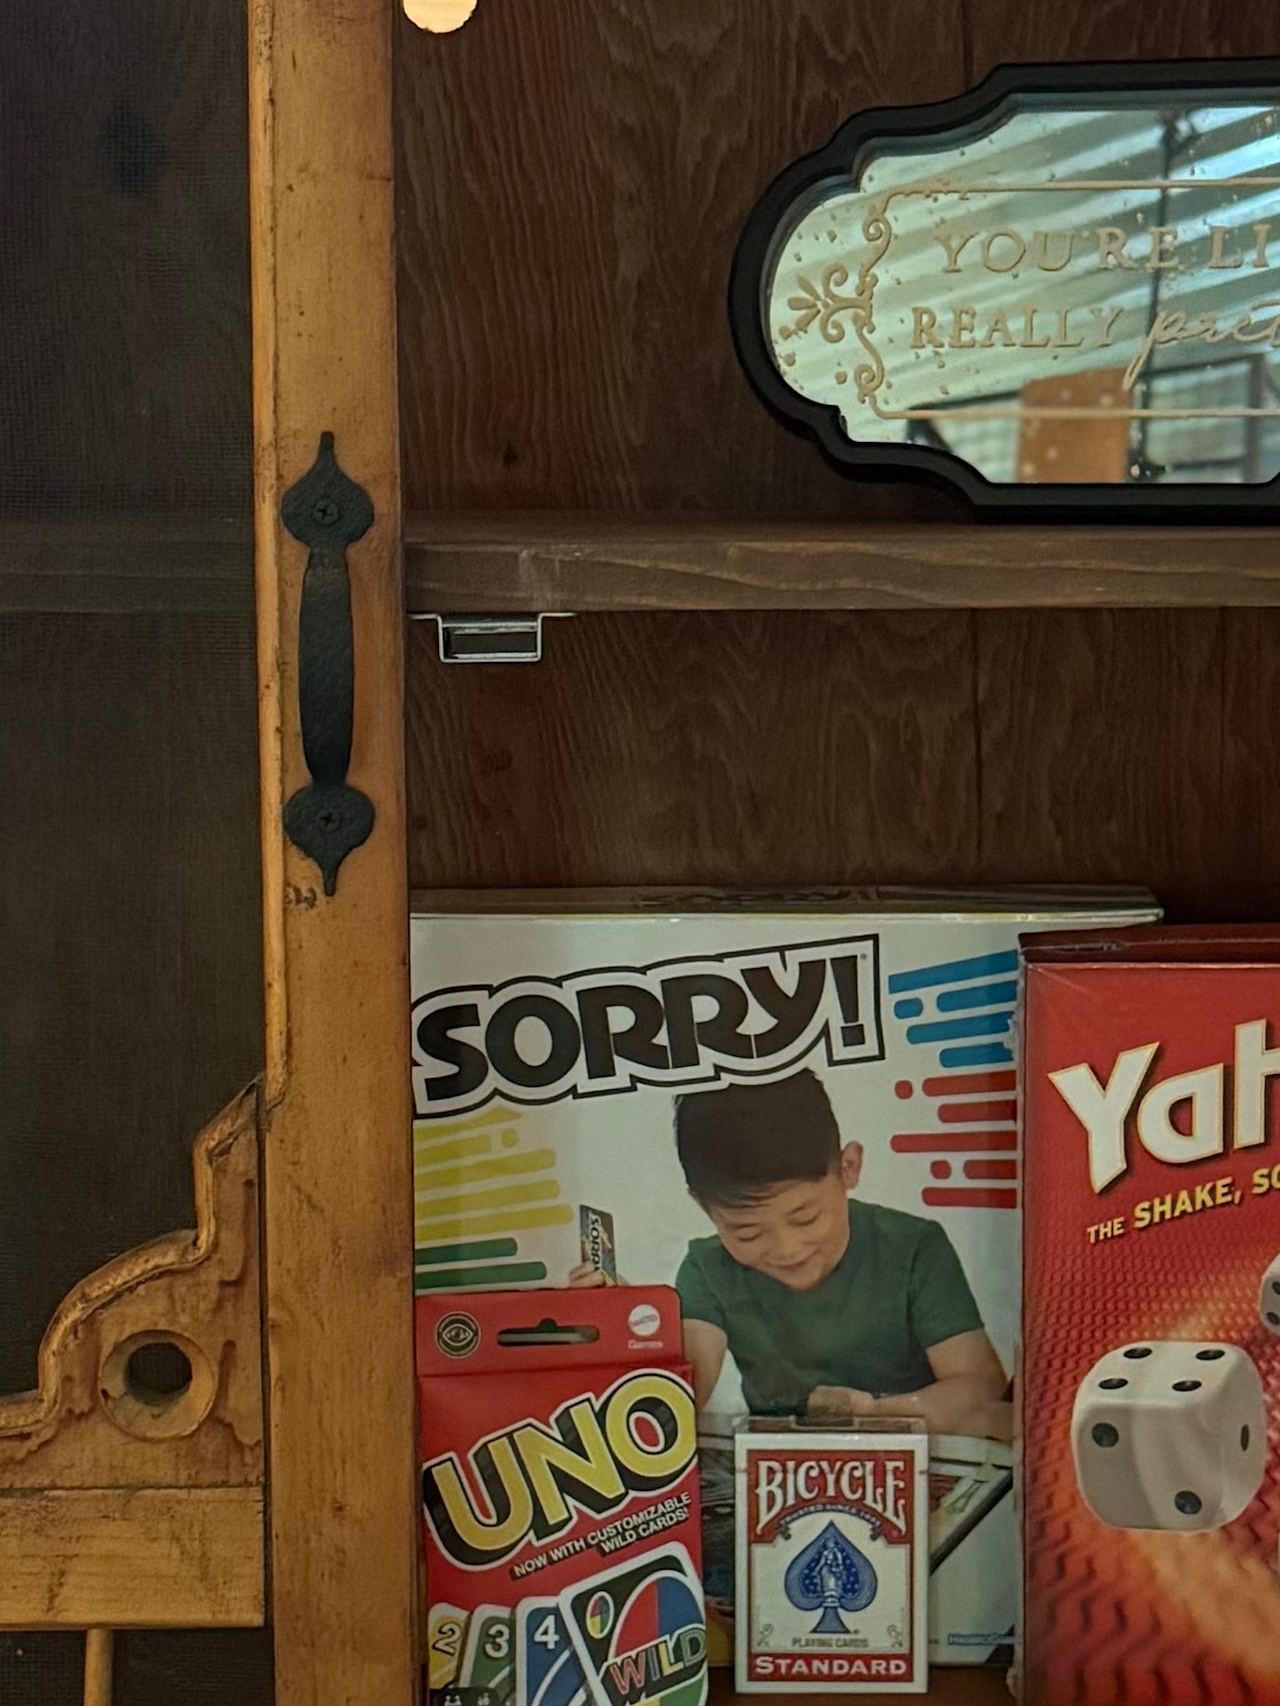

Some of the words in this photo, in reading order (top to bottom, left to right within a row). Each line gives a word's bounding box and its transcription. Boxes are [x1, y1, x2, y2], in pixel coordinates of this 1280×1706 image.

[933, 226, 1182, 273] YOU'RE
[910, 305, 1124, 350] REALLY
[415, 953, 867, 1099] SORRY!
[1086, 1217, 1125, 1244] THE
[1133, 1176, 1242, 1229] SHAKE,
[426, 1372, 698, 1557] UNO
[754, 1460, 908, 1535] BICYCLE
[512, 1553, 548, 1578] NOW
[549, 1538, 586, 1562] WITH
[587, 1492, 693, 1546] CUSTOMIZABLE
[600, 1529, 638, 1554] WILD
[638, 1506, 690, 1538] CARDS!
[433, 1621, 462, 1657] 2
[484, 1623, 511, 1659] 3
[533, 1614, 560, 1650] 4
[608, 1628, 707, 1696] WILD
[754, 1655, 907, 1676] STANDARD
